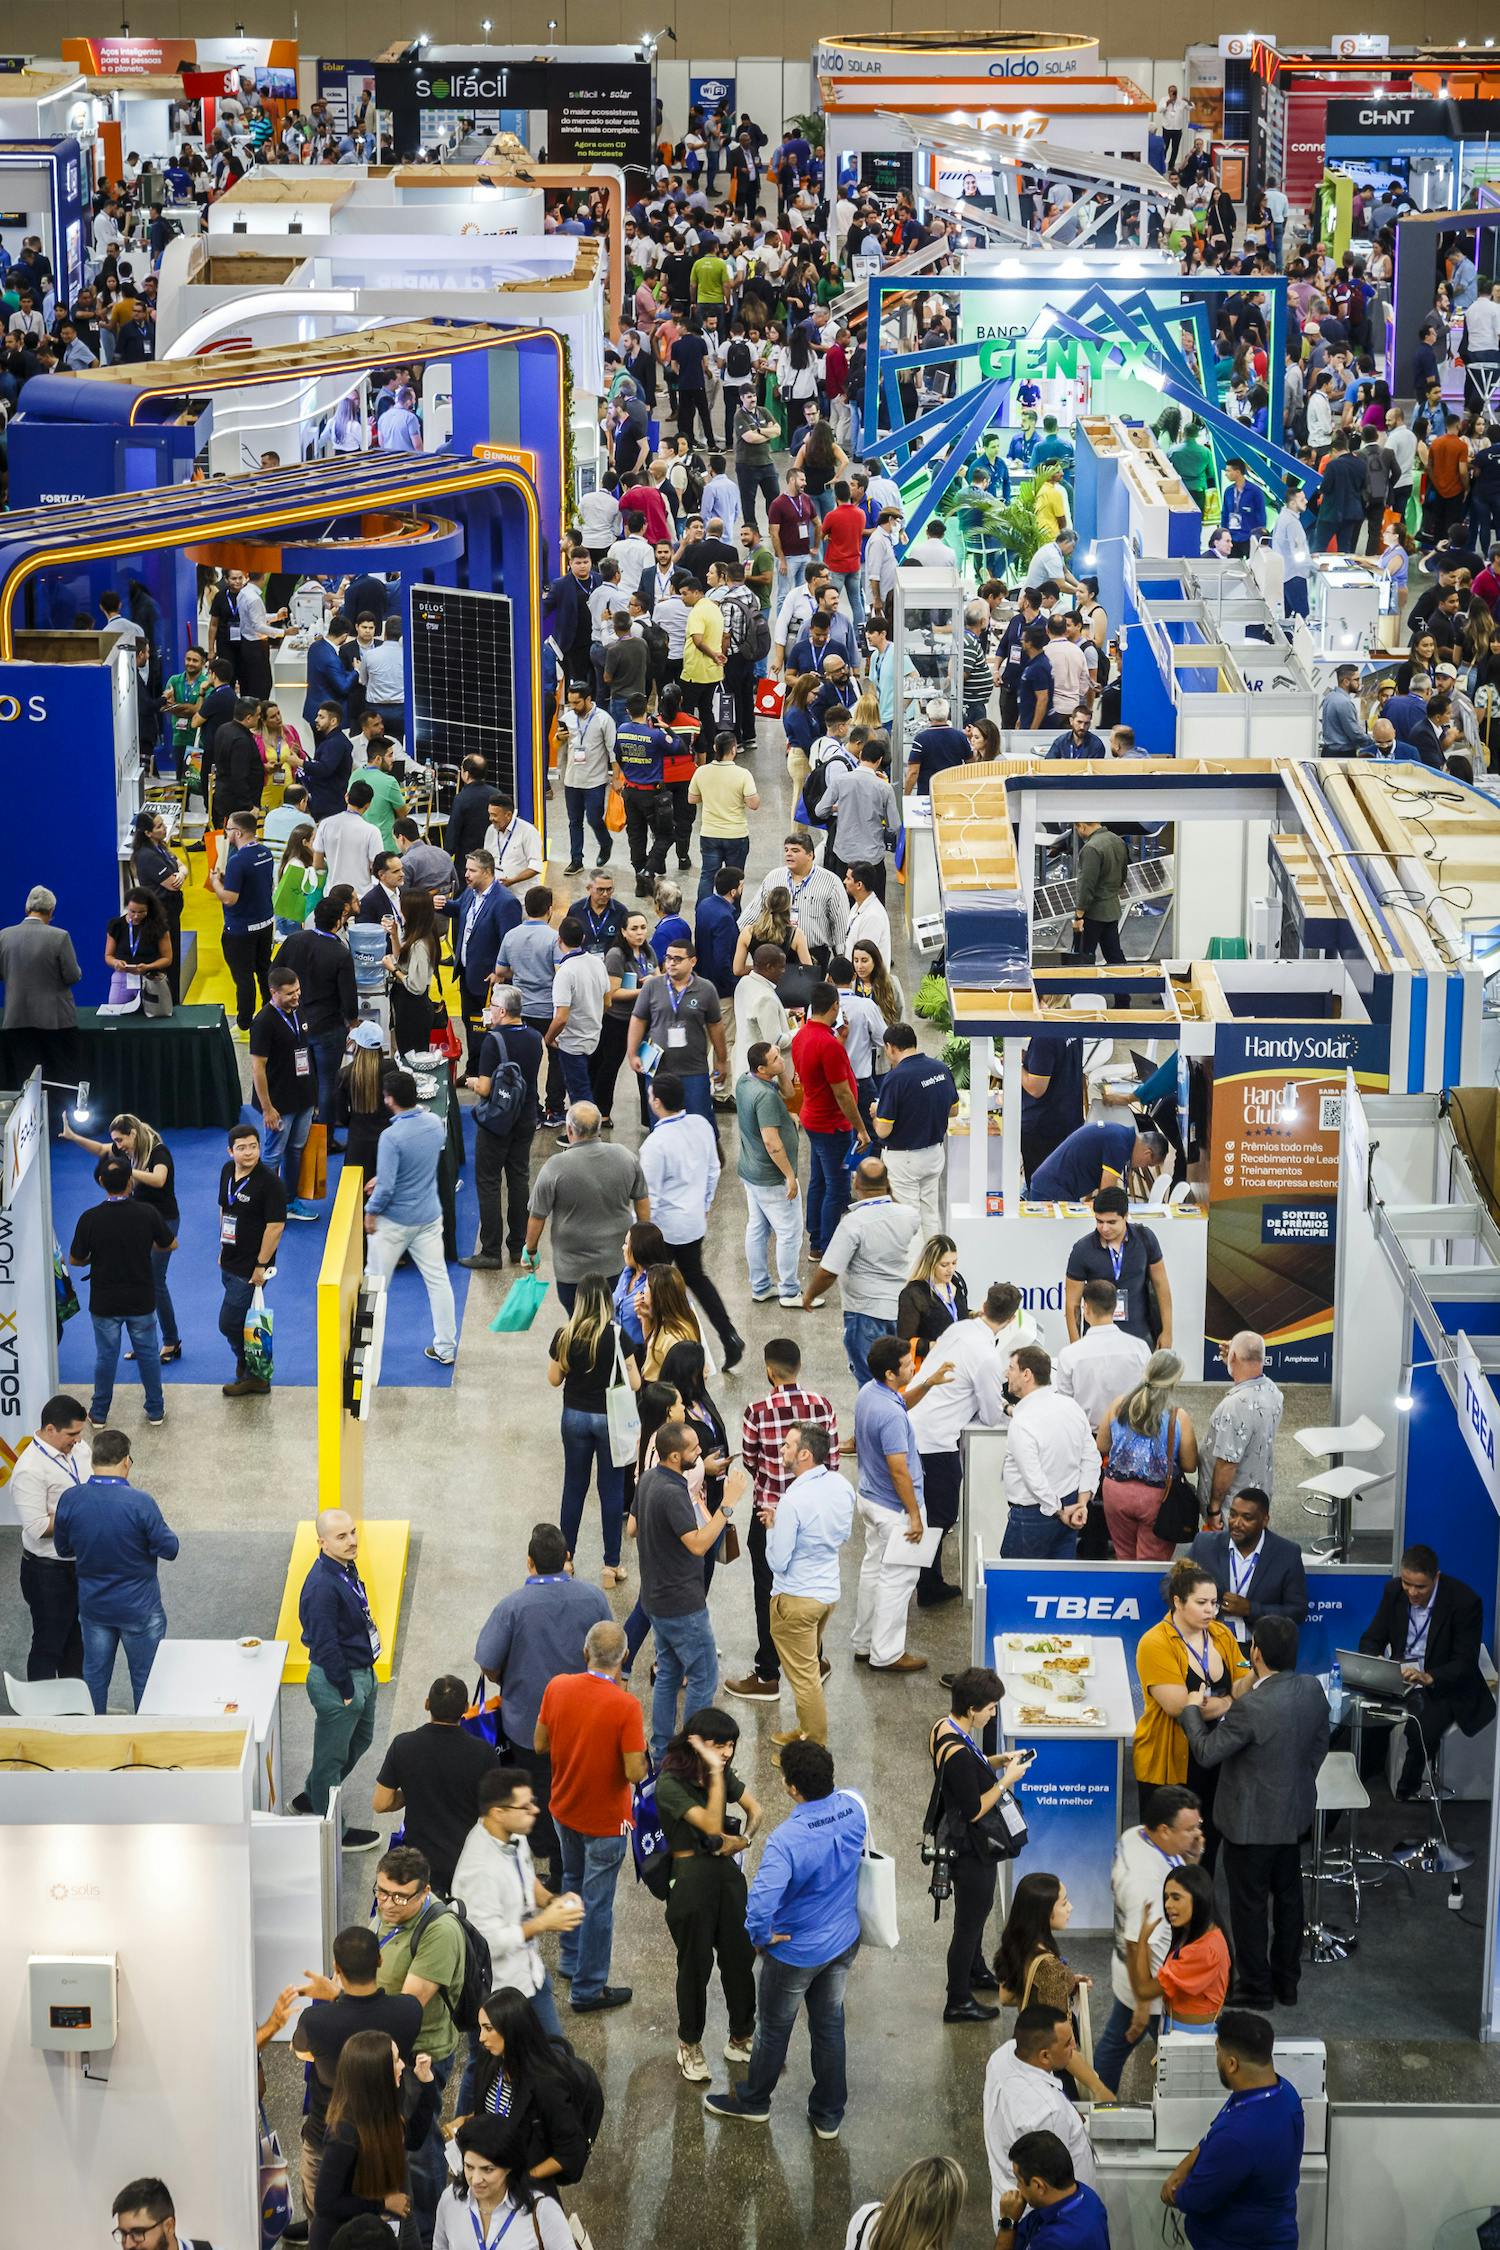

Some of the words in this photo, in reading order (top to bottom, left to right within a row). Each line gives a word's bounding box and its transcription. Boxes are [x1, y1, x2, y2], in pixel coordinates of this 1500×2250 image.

[100, 47, 119, 56] Aços
[120, 47, 162, 57] inteligentes
[100, 57, 119, 66] para
[131, 57, 162, 66] pessoas
[848, 60, 882, 73] SOLAR
[988, 55, 1040, 77] aldo
[1045, 60, 1077, 75] SOLAR
[609, 89, 632, 98] solar
[979, 338, 1150, 380] GENYX
[419, 603, 444, 612] DELOS
[1244, 1036, 1351, 1061] HandySolar
[1241, 1141, 1279, 1152] Prêmios
[1280, 1142, 1301, 1152] todo
[1303, 1142, 1323, 1152] mês
[1241, 1153, 1301, 1164] Recebimento
[1303, 1155, 1314, 1164] de
[1240, 1165, 1302, 1176] Treinamentos
[1240, 1177, 1266, 1187] Troca
[1267, 1178, 1308, 1189] expressa
[1282, 1211, 1327, 1220] SORTEIO
[1266, 1220, 1281, 1228] DE
[1282, 1218, 1329, 1228] PRÊMIOS
[1284, 1355, 1319, 1363] Amphenol
[1464, 1371, 1495, 1471] TBEA
[1026, 1596, 1141, 1620] TBEA
[1317, 1601, 1343, 1611] para
[1021, 1783, 1057, 1793] Energia
[1059, 1784, 1086, 1792] verde
[1088, 1785, 1110, 1793] para
[1036, 1796, 1057, 1805] Vida
[1059, 1797, 1094, 1805] melhor
[808, 1817, 837, 1830] ENERGIA
